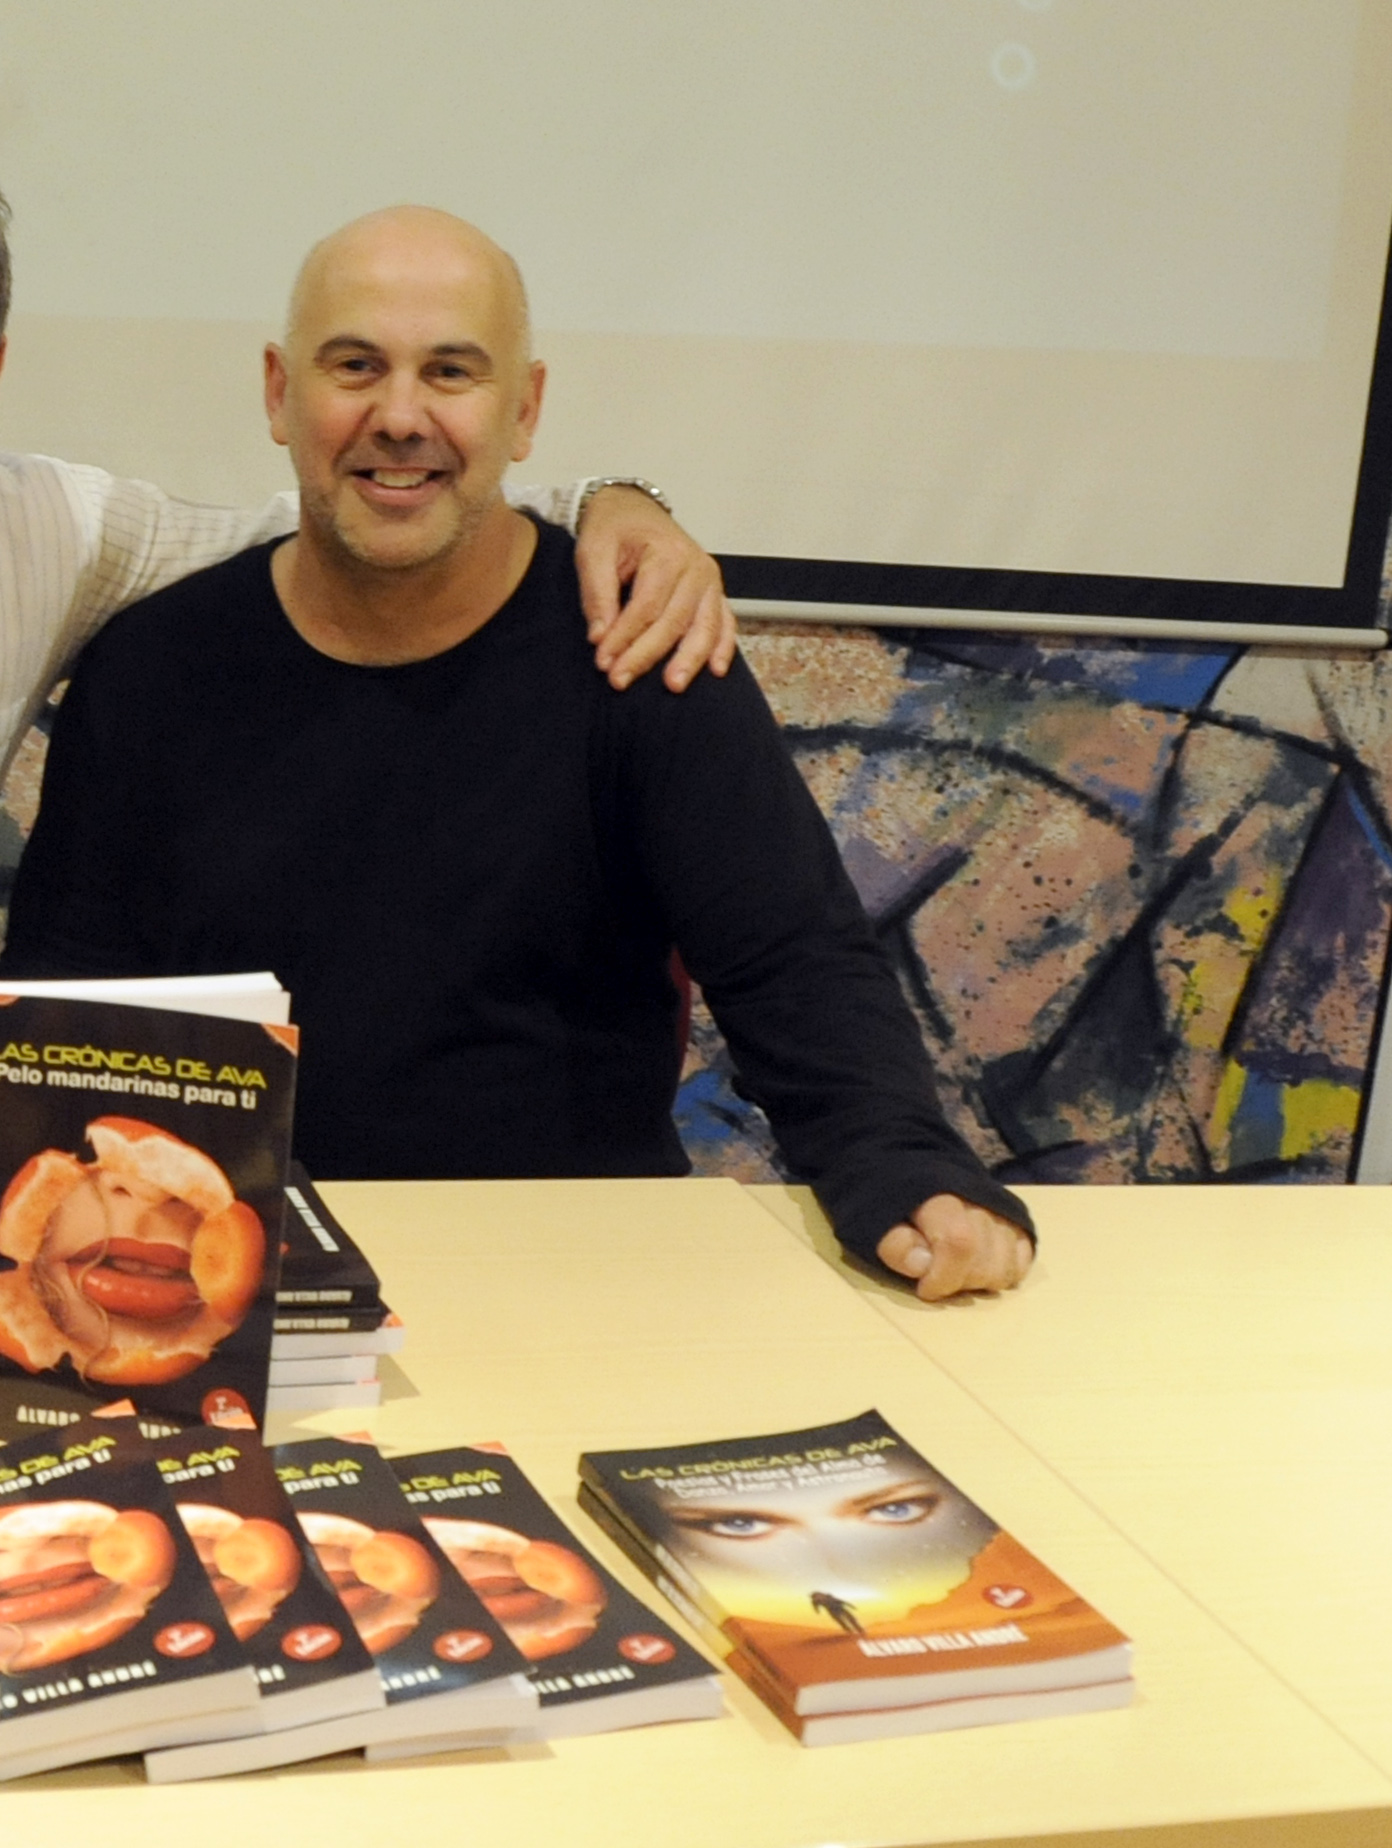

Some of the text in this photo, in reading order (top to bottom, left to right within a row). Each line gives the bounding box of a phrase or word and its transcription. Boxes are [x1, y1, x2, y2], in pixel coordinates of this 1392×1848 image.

[43, 1045, 171, 1076] CRÓNICAS
[176, 1058, 212, 1081] DE
[216, 1065, 268, 1089] AVA
[47, 1070, 181, 1098] mandarinas
[183, 1085, 236, 1105] para
[240, 1090, 257, 1109] ti
[19, 1455, 59, 1475] DE
[63, 1435, 117, 1461] AVA
[34, 1457, 91, 1485] para
[92, 1447, 112, 1464] ti
[187, 1445, 241, 1467] AVA
[216, 1457, 236, 1473] ti
[619, 1465, 674, 1481] LAS
[806, 1449, 842, 1462] DE
[847, 1436, 897, 1456] AVA
[310, 1459, 363, 1477] AVA
[452, 1468, 502, 1485] AVA
[283, 1471, 360, 1495] para ti
[430, 1484, 484, 1503] para
[21, 1677, 84, 1704] VILLA
